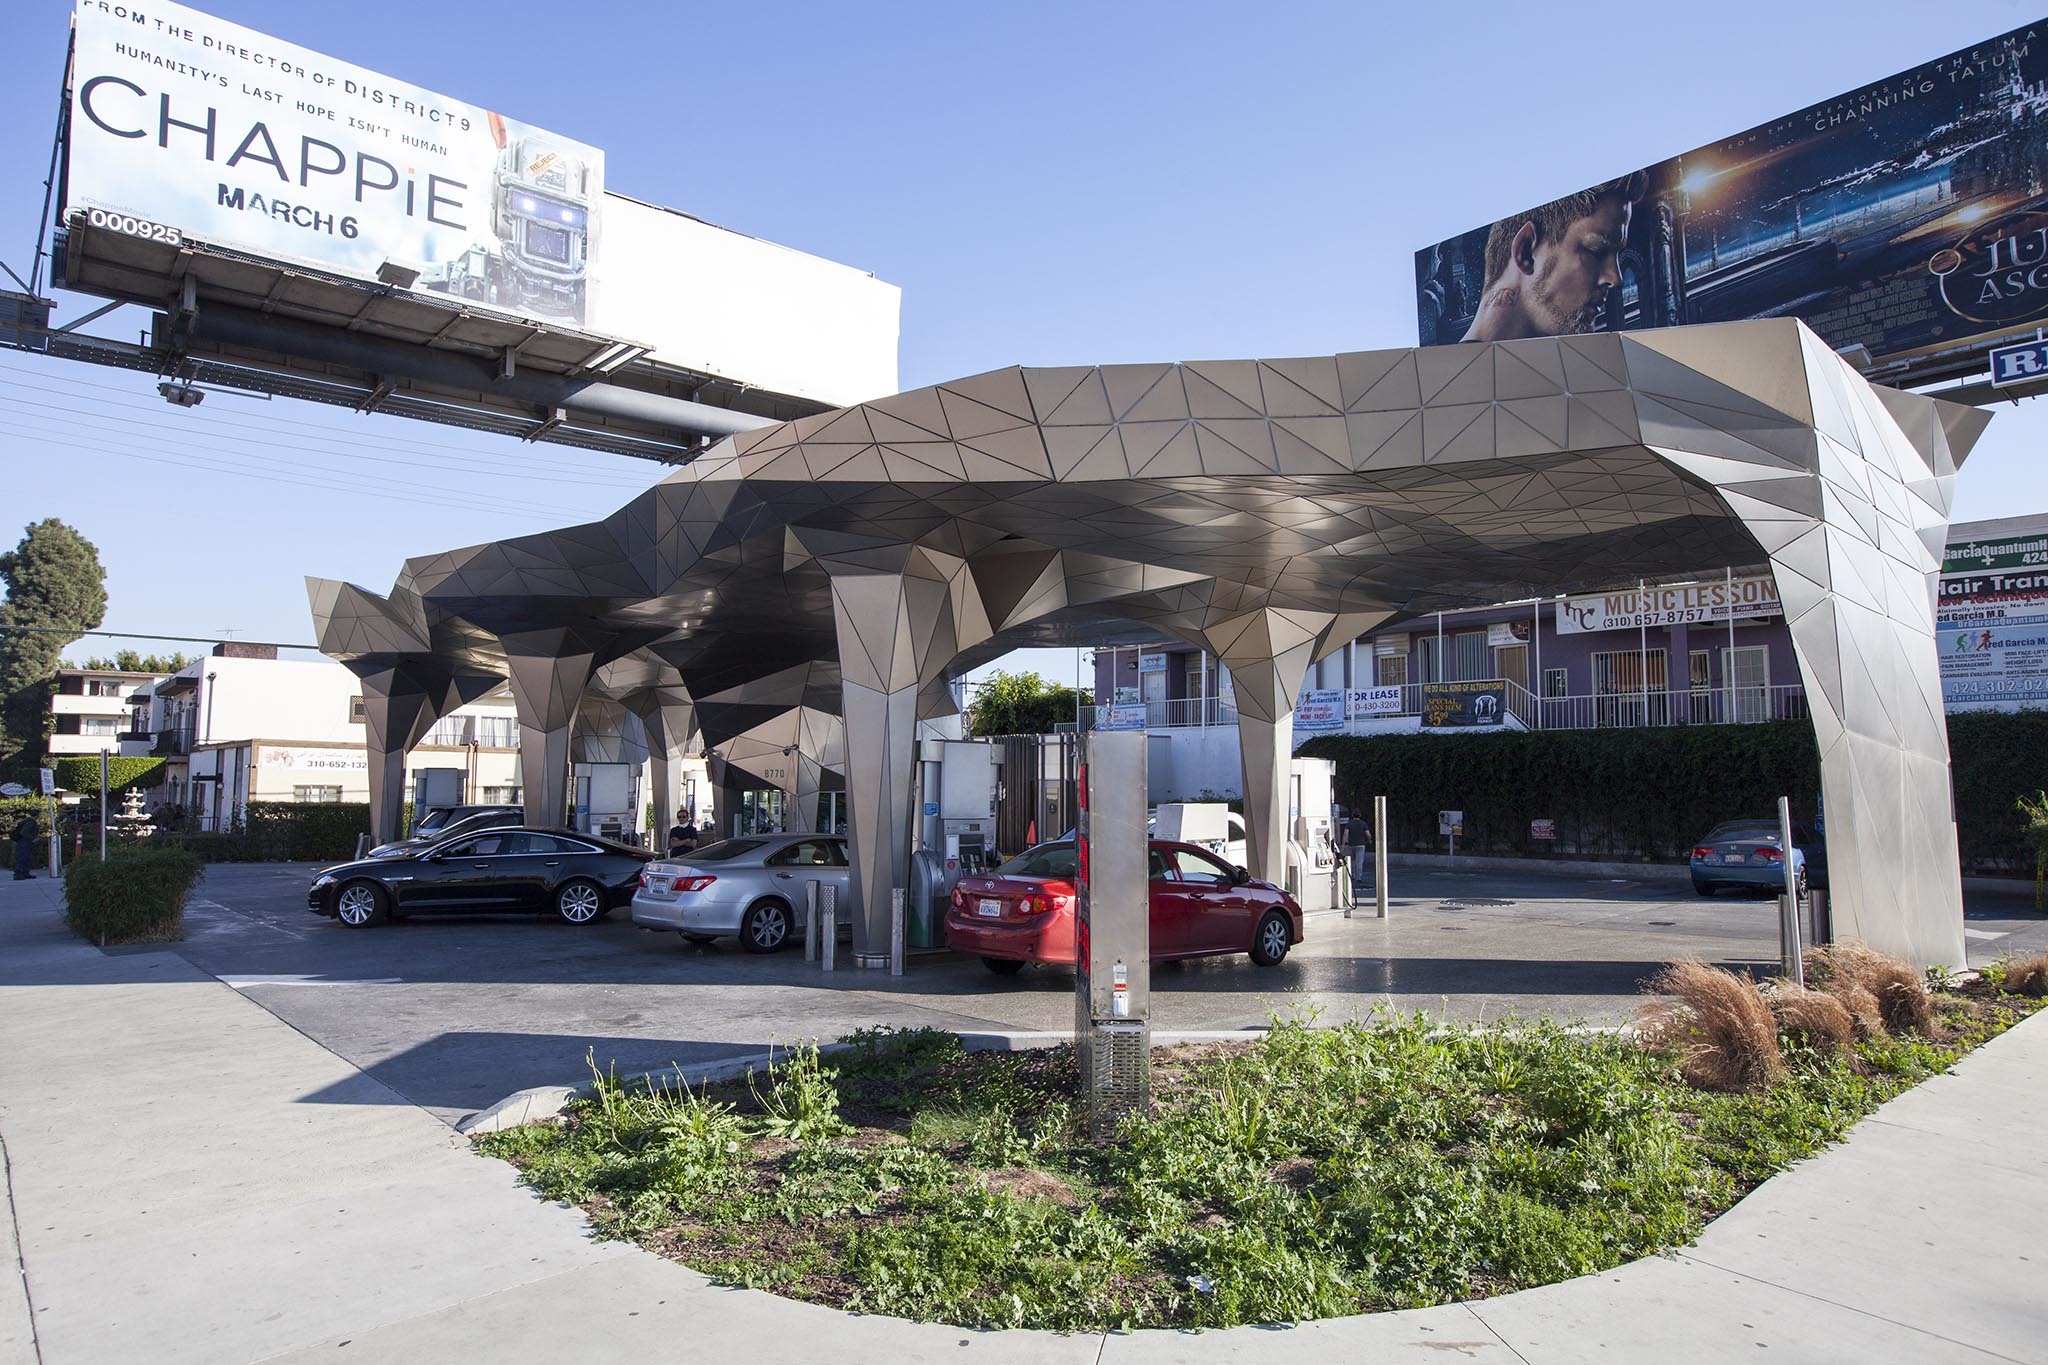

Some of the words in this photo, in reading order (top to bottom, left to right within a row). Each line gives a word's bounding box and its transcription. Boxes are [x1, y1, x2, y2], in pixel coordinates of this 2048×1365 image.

[154, 18, 194, 42] THE
[203, 35, 305, 78] DIRECTOR
[313, 73, 336, 87] OF
[1768, 121, 1793, 135] THE
[1805, 86, 1889, 121] CREATORS
[1903, 74, 1922, 86] OF
[1936, 50, 1980, 73] THE
[1814, 80, 1935, 131] CHANNING
[1948, 44, 2029, 83] TATUM
[116, 42, 229, 88] HUMANITY'S
[242, 83, 284, 104] LAST
[296, 100, 336, 121] HOPE
[348, 116, 391, 138] ISN'T
[402, 133, 447, 156] HUMAN
[529, 153, 557, 172] REJECT
[217, 183, 333, 235] MARCH
[340, 215, 359, 239] 6
[90, 208, 181, 246] 000925
[2000, 347, 2048, 378] R
[1604, 590, 1676, 617] MUSIC
[1684, 580, 1777, 609] LESSON
[1603, 616, 1631, 629] (310)
[1634, 608, 1704, 626] 657-8757
[1951, 611, 1984, 621] Garcia
[1986, 609, 2007, 618] M.D.
[2005, 638, 2035, 648] Garcia
[1370, 689, 1399, 700] LEASE
[1439, 684, 1449, 693] ALL
[1346, 700, 1400, 712] 30-430-3200
[307, 760, 367, 769] 310-652-132
[764, 769, 785, 778] 8770
